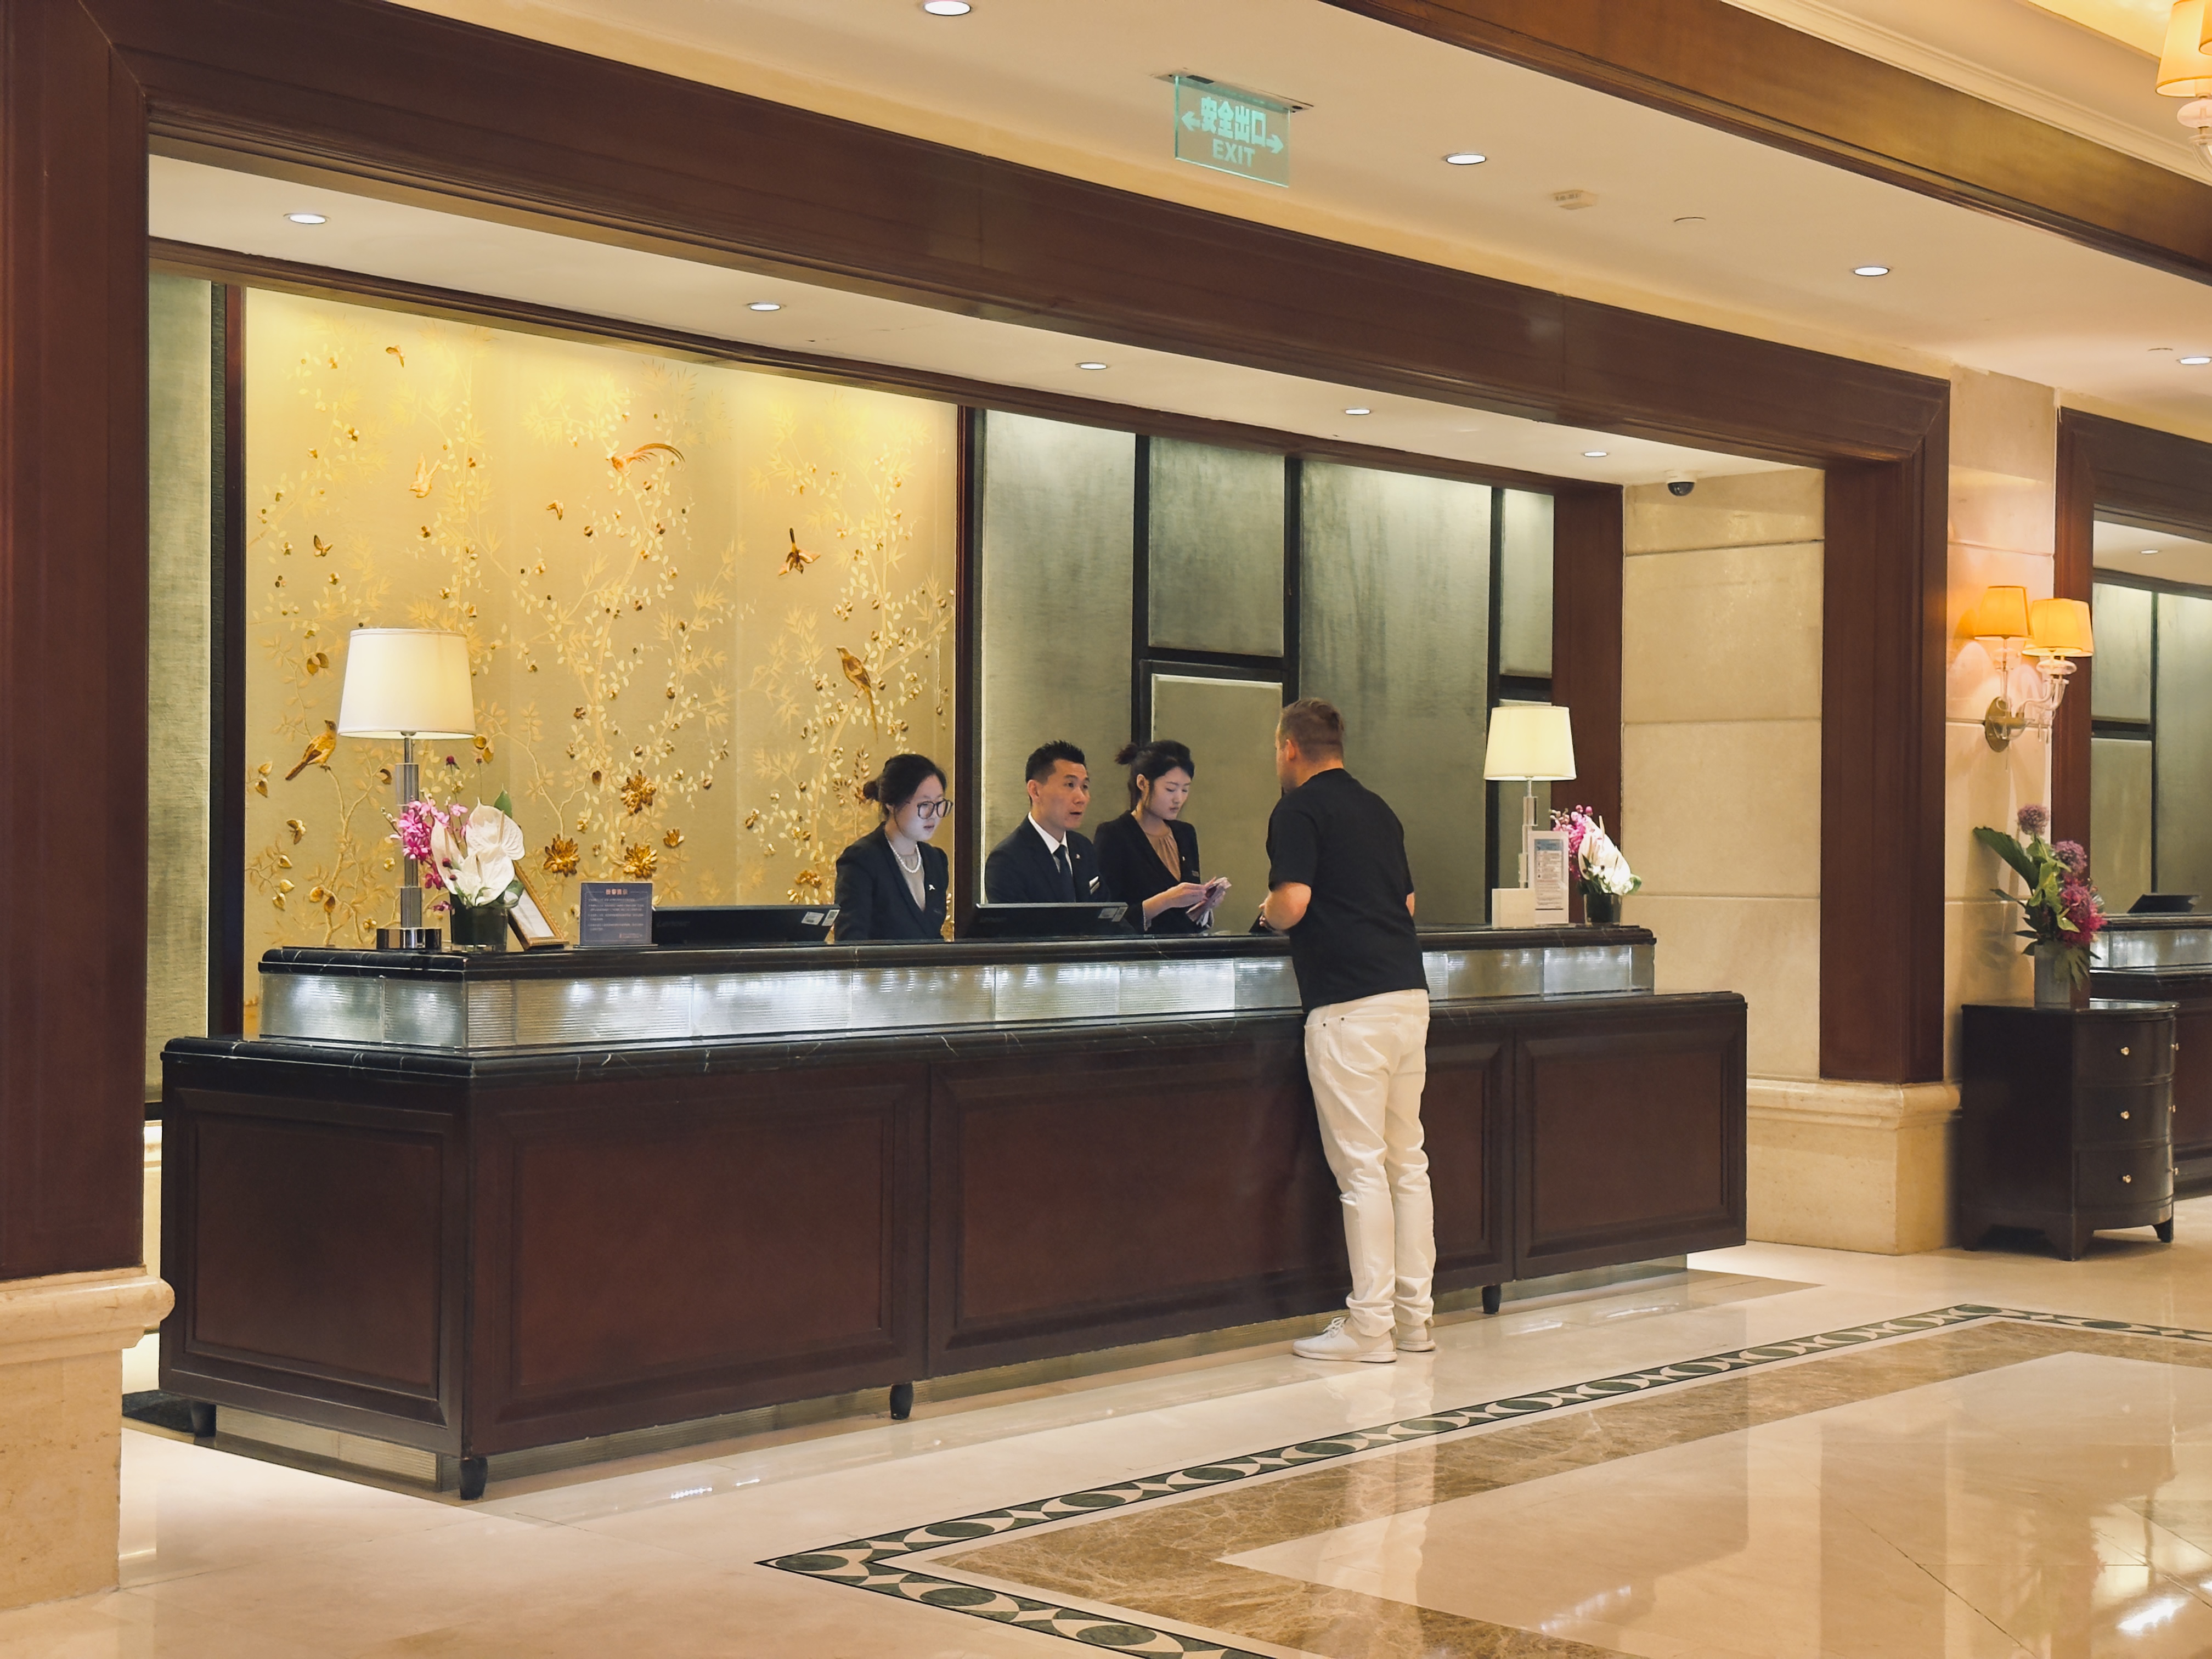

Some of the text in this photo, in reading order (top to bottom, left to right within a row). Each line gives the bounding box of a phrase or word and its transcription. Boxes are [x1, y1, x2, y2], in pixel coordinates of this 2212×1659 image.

[1201, 97, 1266, 147] 安全出口
[1212, 139, 1255, 167] EXIT
